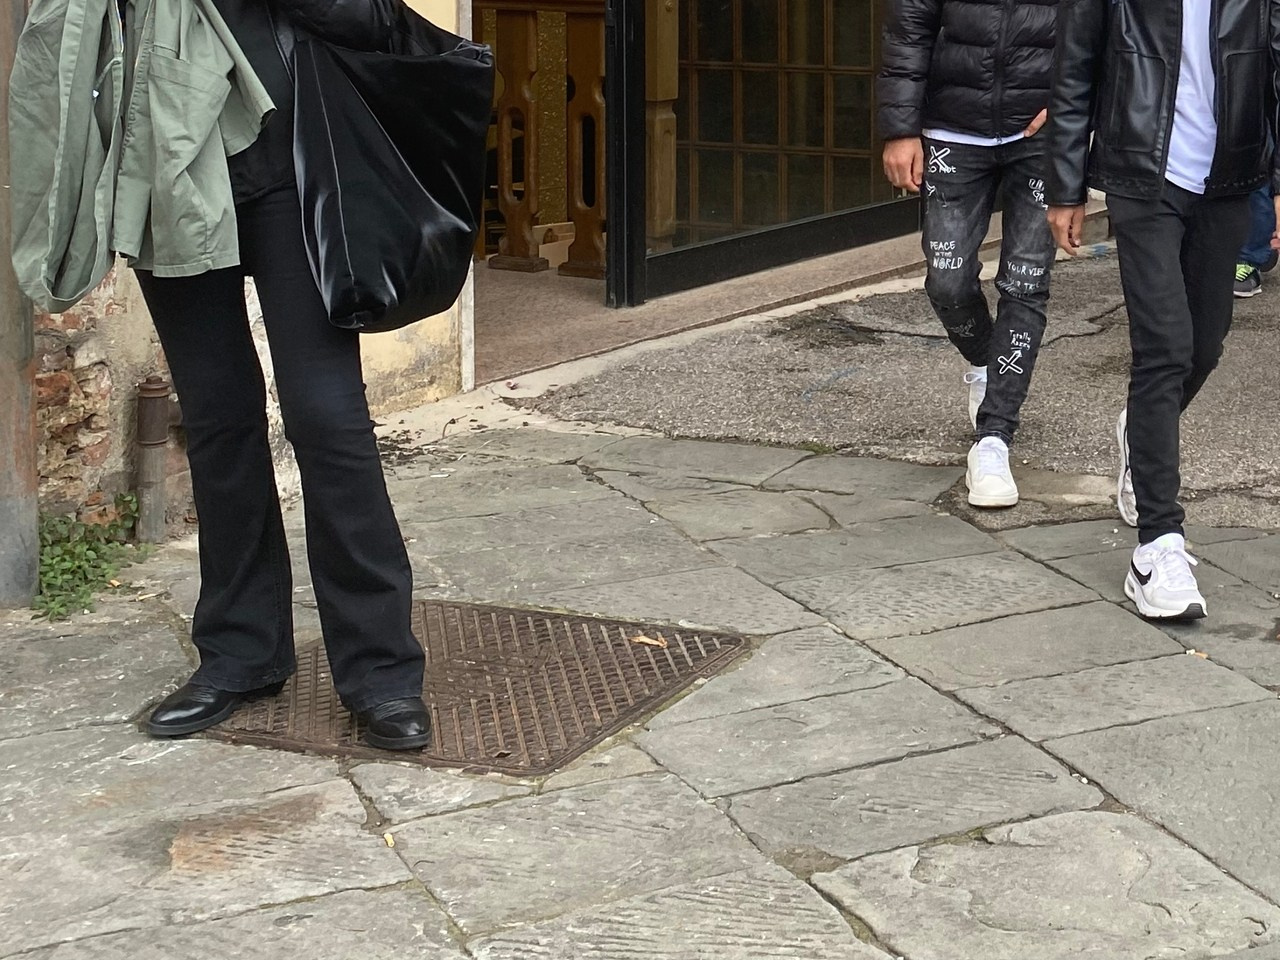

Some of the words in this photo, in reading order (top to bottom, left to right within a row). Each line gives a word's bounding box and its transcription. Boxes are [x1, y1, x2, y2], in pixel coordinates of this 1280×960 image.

[930, 240, 956, 251] PEACE
[933, 256, 963, 270] WORLD
[1007, 260, 1027, 276] YOUR
